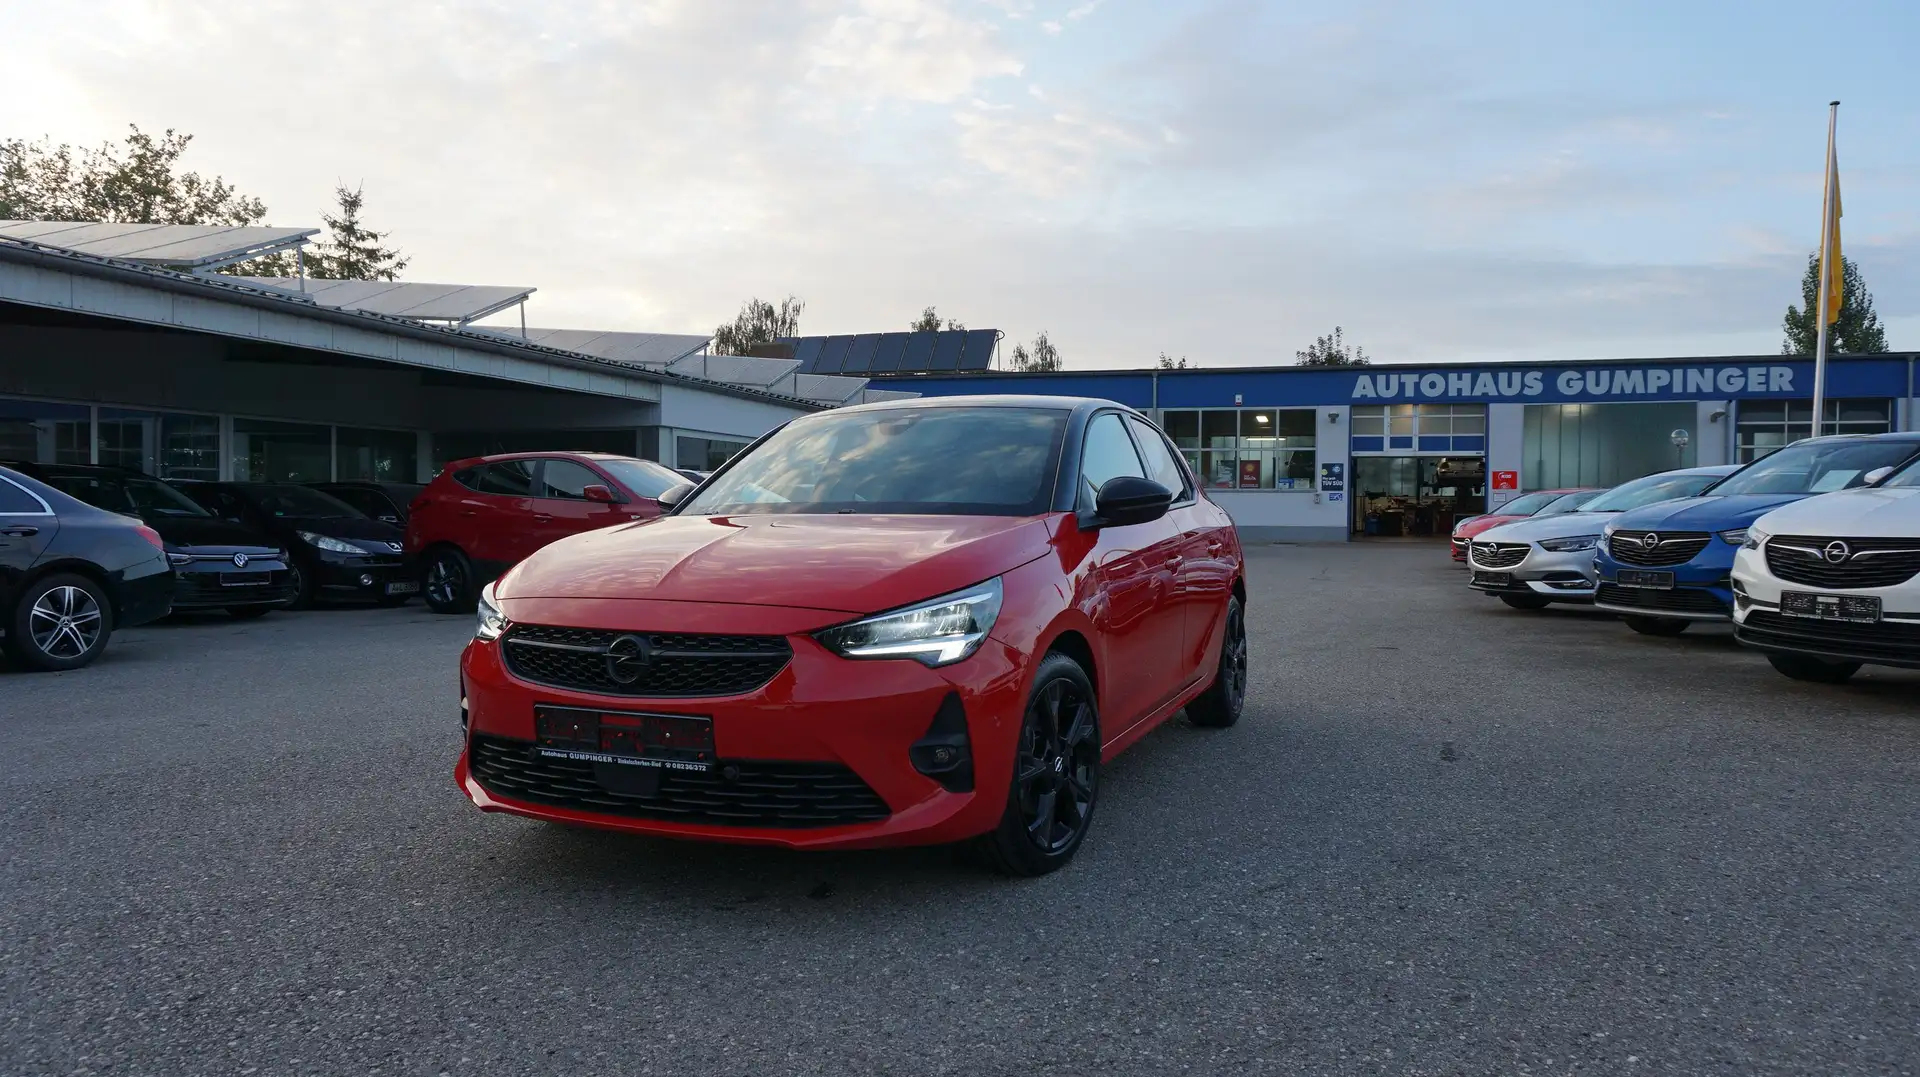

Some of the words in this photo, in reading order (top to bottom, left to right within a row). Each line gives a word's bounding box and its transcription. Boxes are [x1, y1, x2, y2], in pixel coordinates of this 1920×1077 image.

[1351, 370, 1544, 399] AUTOHAUS
[1556, 366, 1795, 396] GUMPINGER
[541, 750, 567, 758] Autohaus
[569, 753, 612, 763] GUMPINGER
